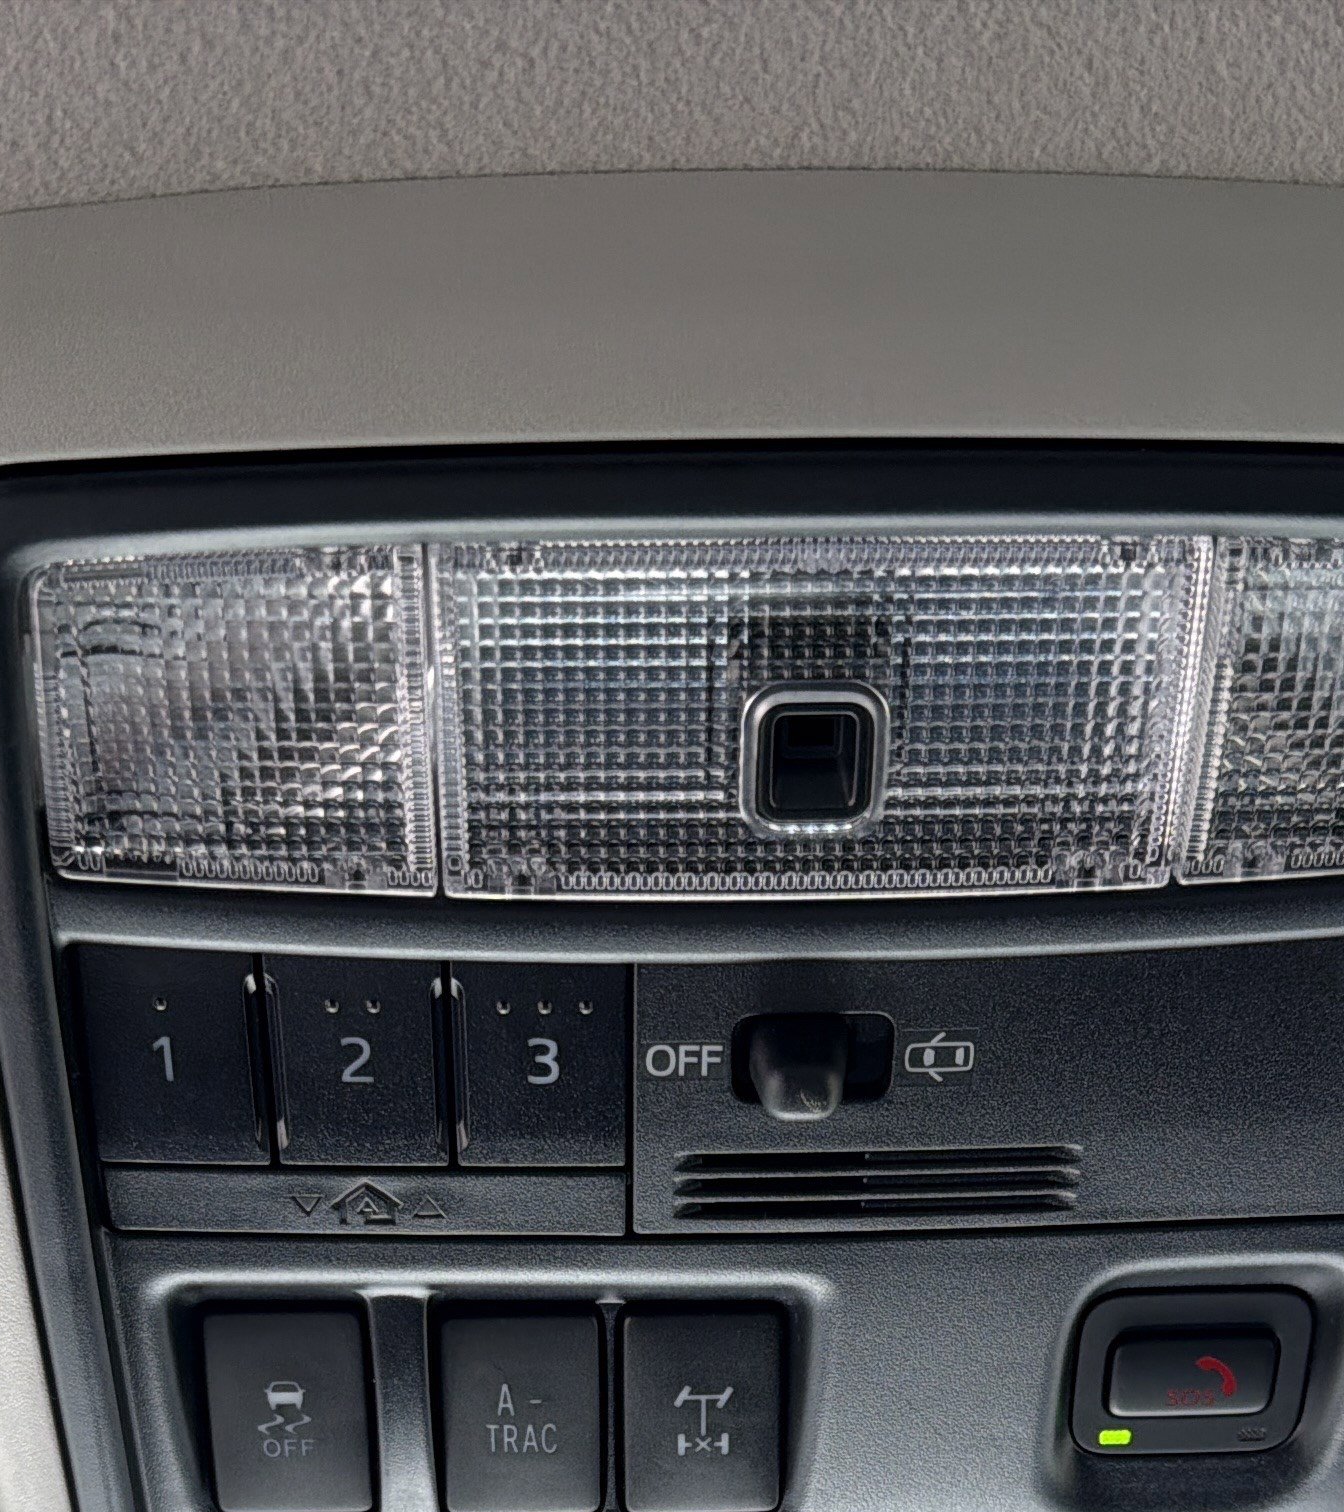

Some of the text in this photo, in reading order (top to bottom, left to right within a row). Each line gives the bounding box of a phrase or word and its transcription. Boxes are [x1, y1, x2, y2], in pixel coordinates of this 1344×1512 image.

[151, 1036, 175, 1083] 1
[340, 1037, 375, 1084] 2
[526, 1037, 560, 1085] 3
[645, 1043, 723, 1077] OFF
[1165, 1388, 1215, 1407] SOS
[263, 1438, 315, 1457] OFF
[486, 1424, 557, 1454] TRAC
